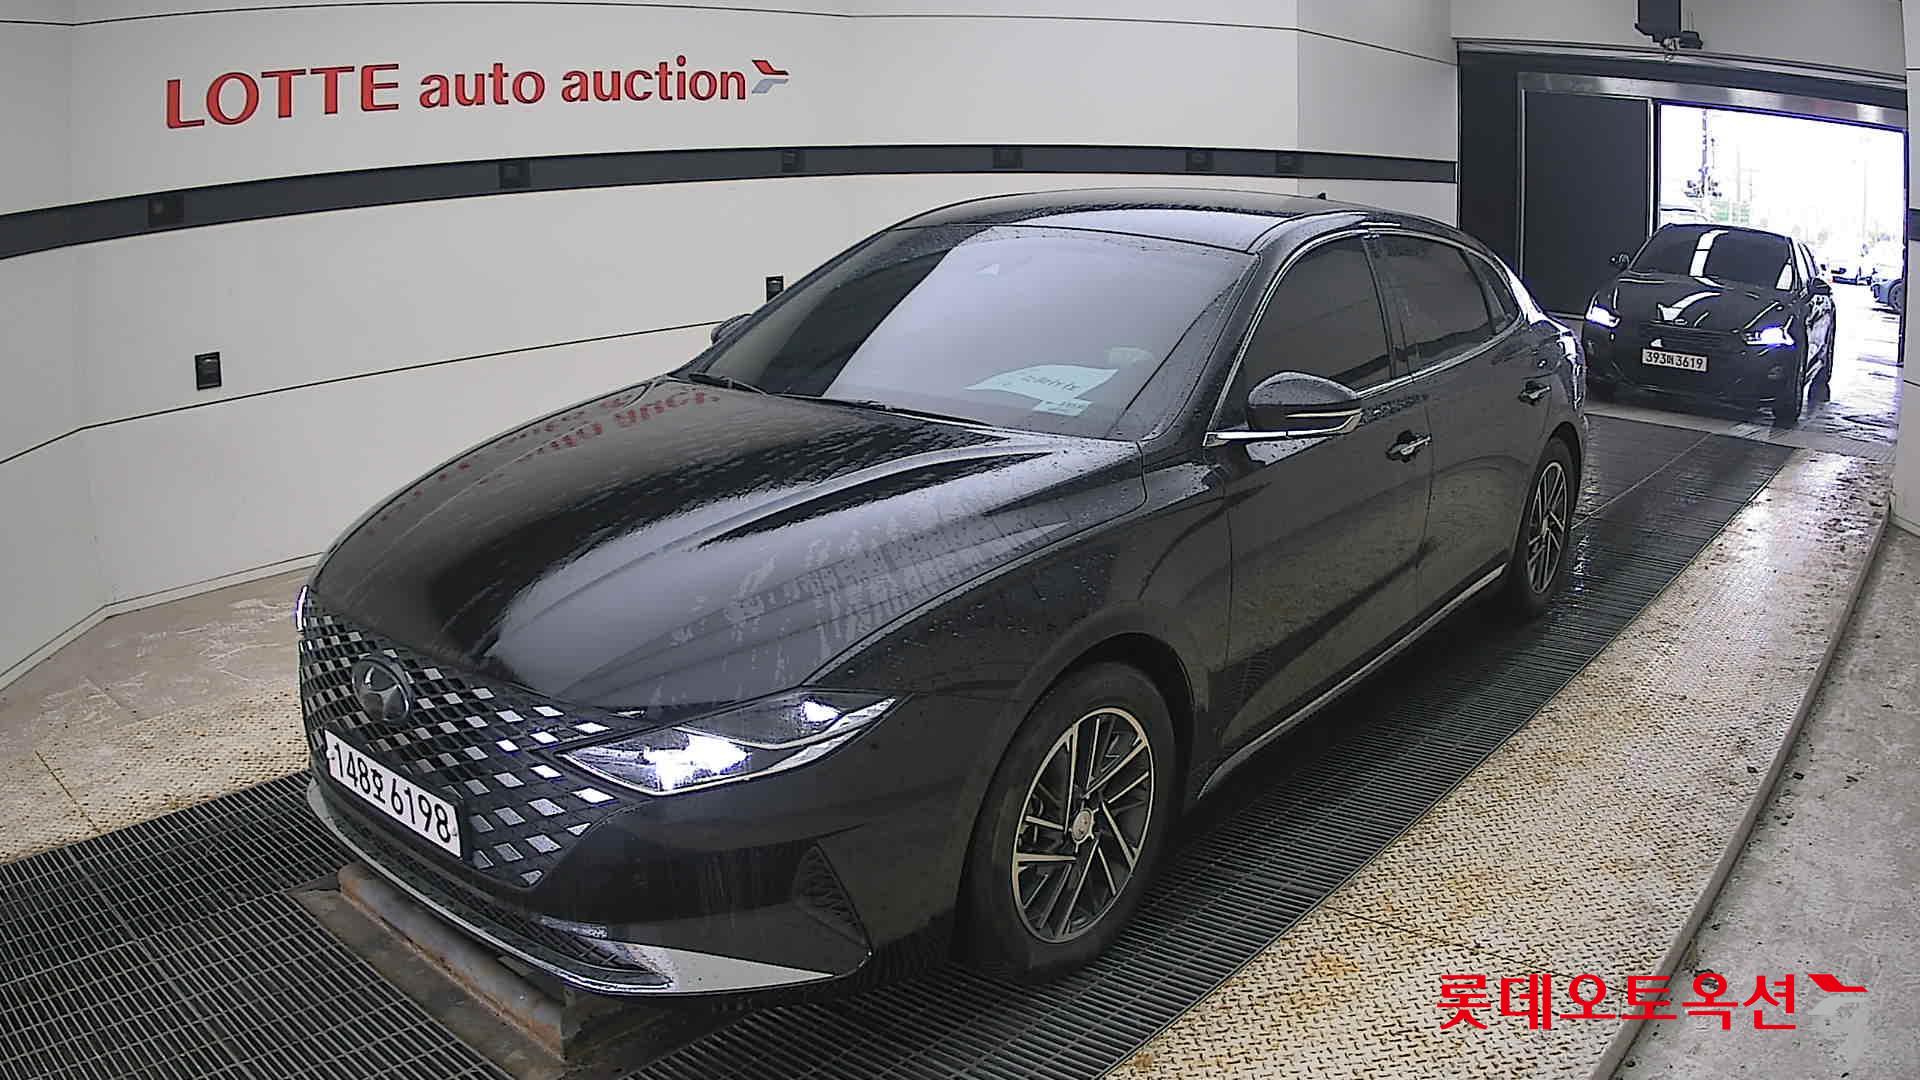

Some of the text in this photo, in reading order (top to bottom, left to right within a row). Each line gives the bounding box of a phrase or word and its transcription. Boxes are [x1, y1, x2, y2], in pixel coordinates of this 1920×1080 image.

[166, 54, 748, 129] LOTTE auto auction
